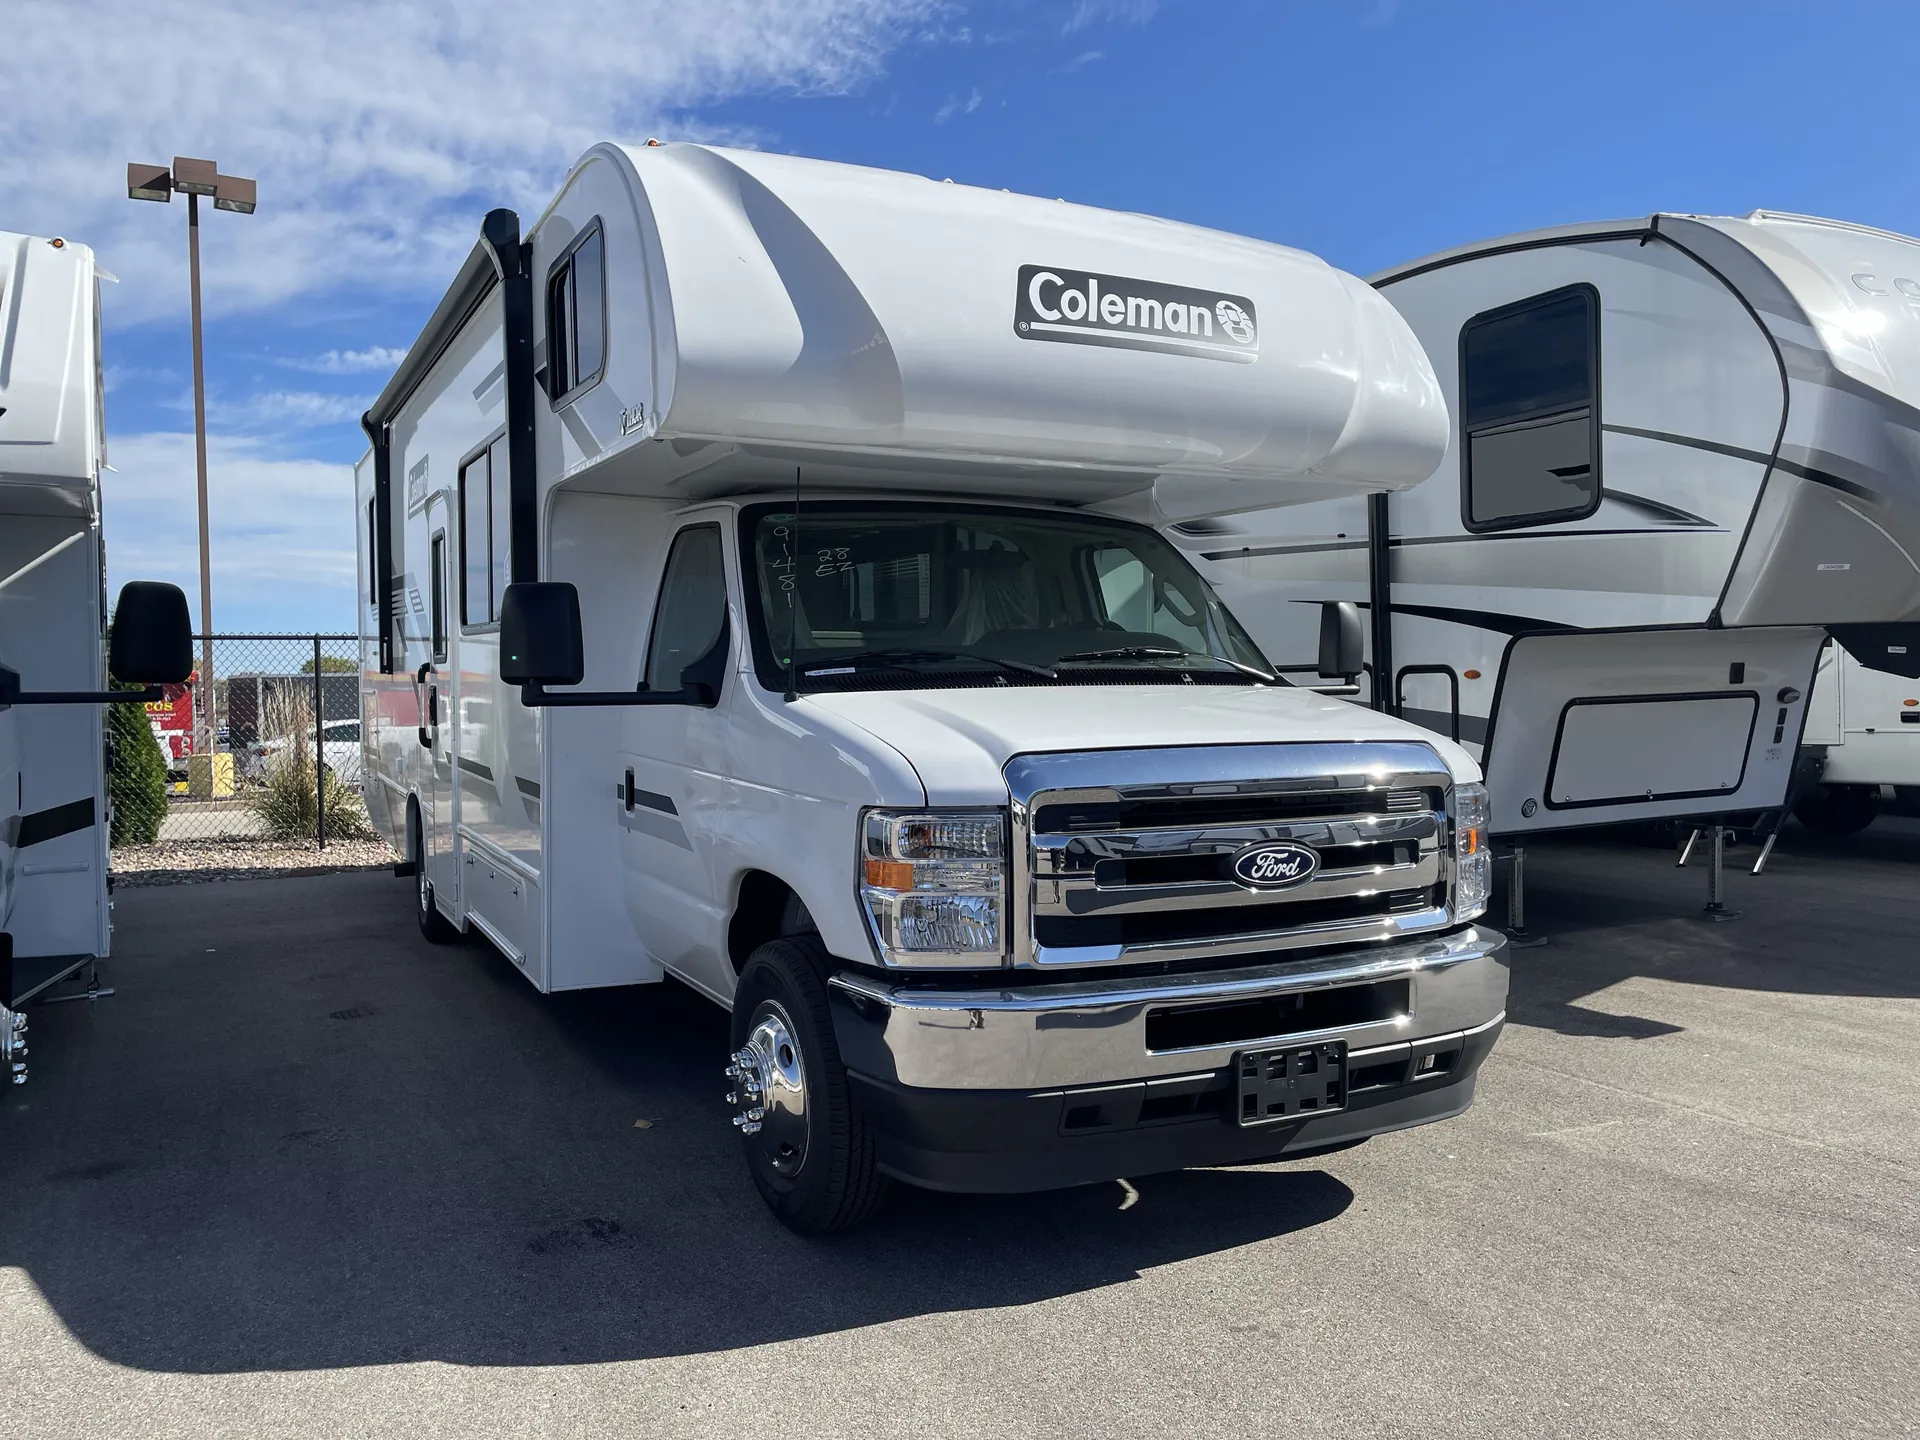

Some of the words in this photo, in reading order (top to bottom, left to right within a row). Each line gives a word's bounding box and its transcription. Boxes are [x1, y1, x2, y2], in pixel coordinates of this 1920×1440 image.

[1028, 271, 1213, 337] Coleman
[817, 548, 850, 562] 28
[1251, 852, 1301, 878] Ford
